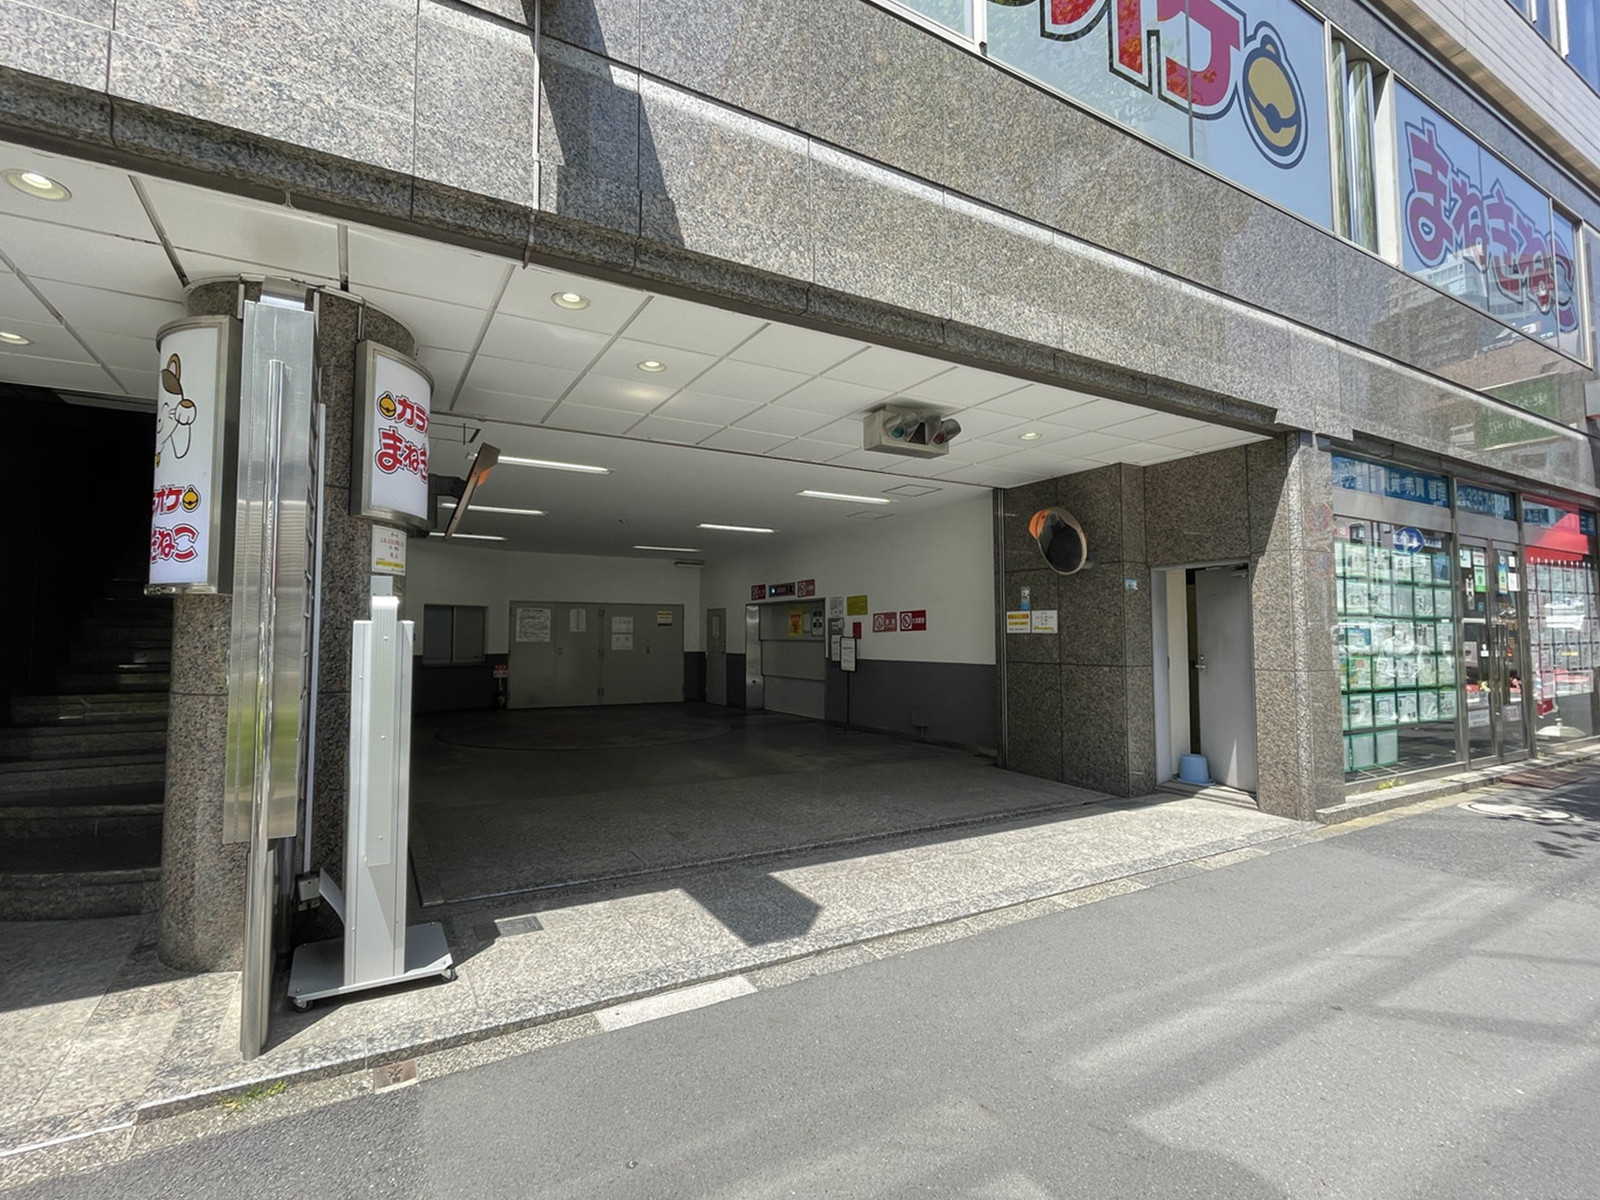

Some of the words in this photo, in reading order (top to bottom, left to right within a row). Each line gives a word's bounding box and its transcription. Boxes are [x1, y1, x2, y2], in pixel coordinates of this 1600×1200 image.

[1404, 118, 1575, 332] まねきねこ
[396, 396, 430, 434] カラ
